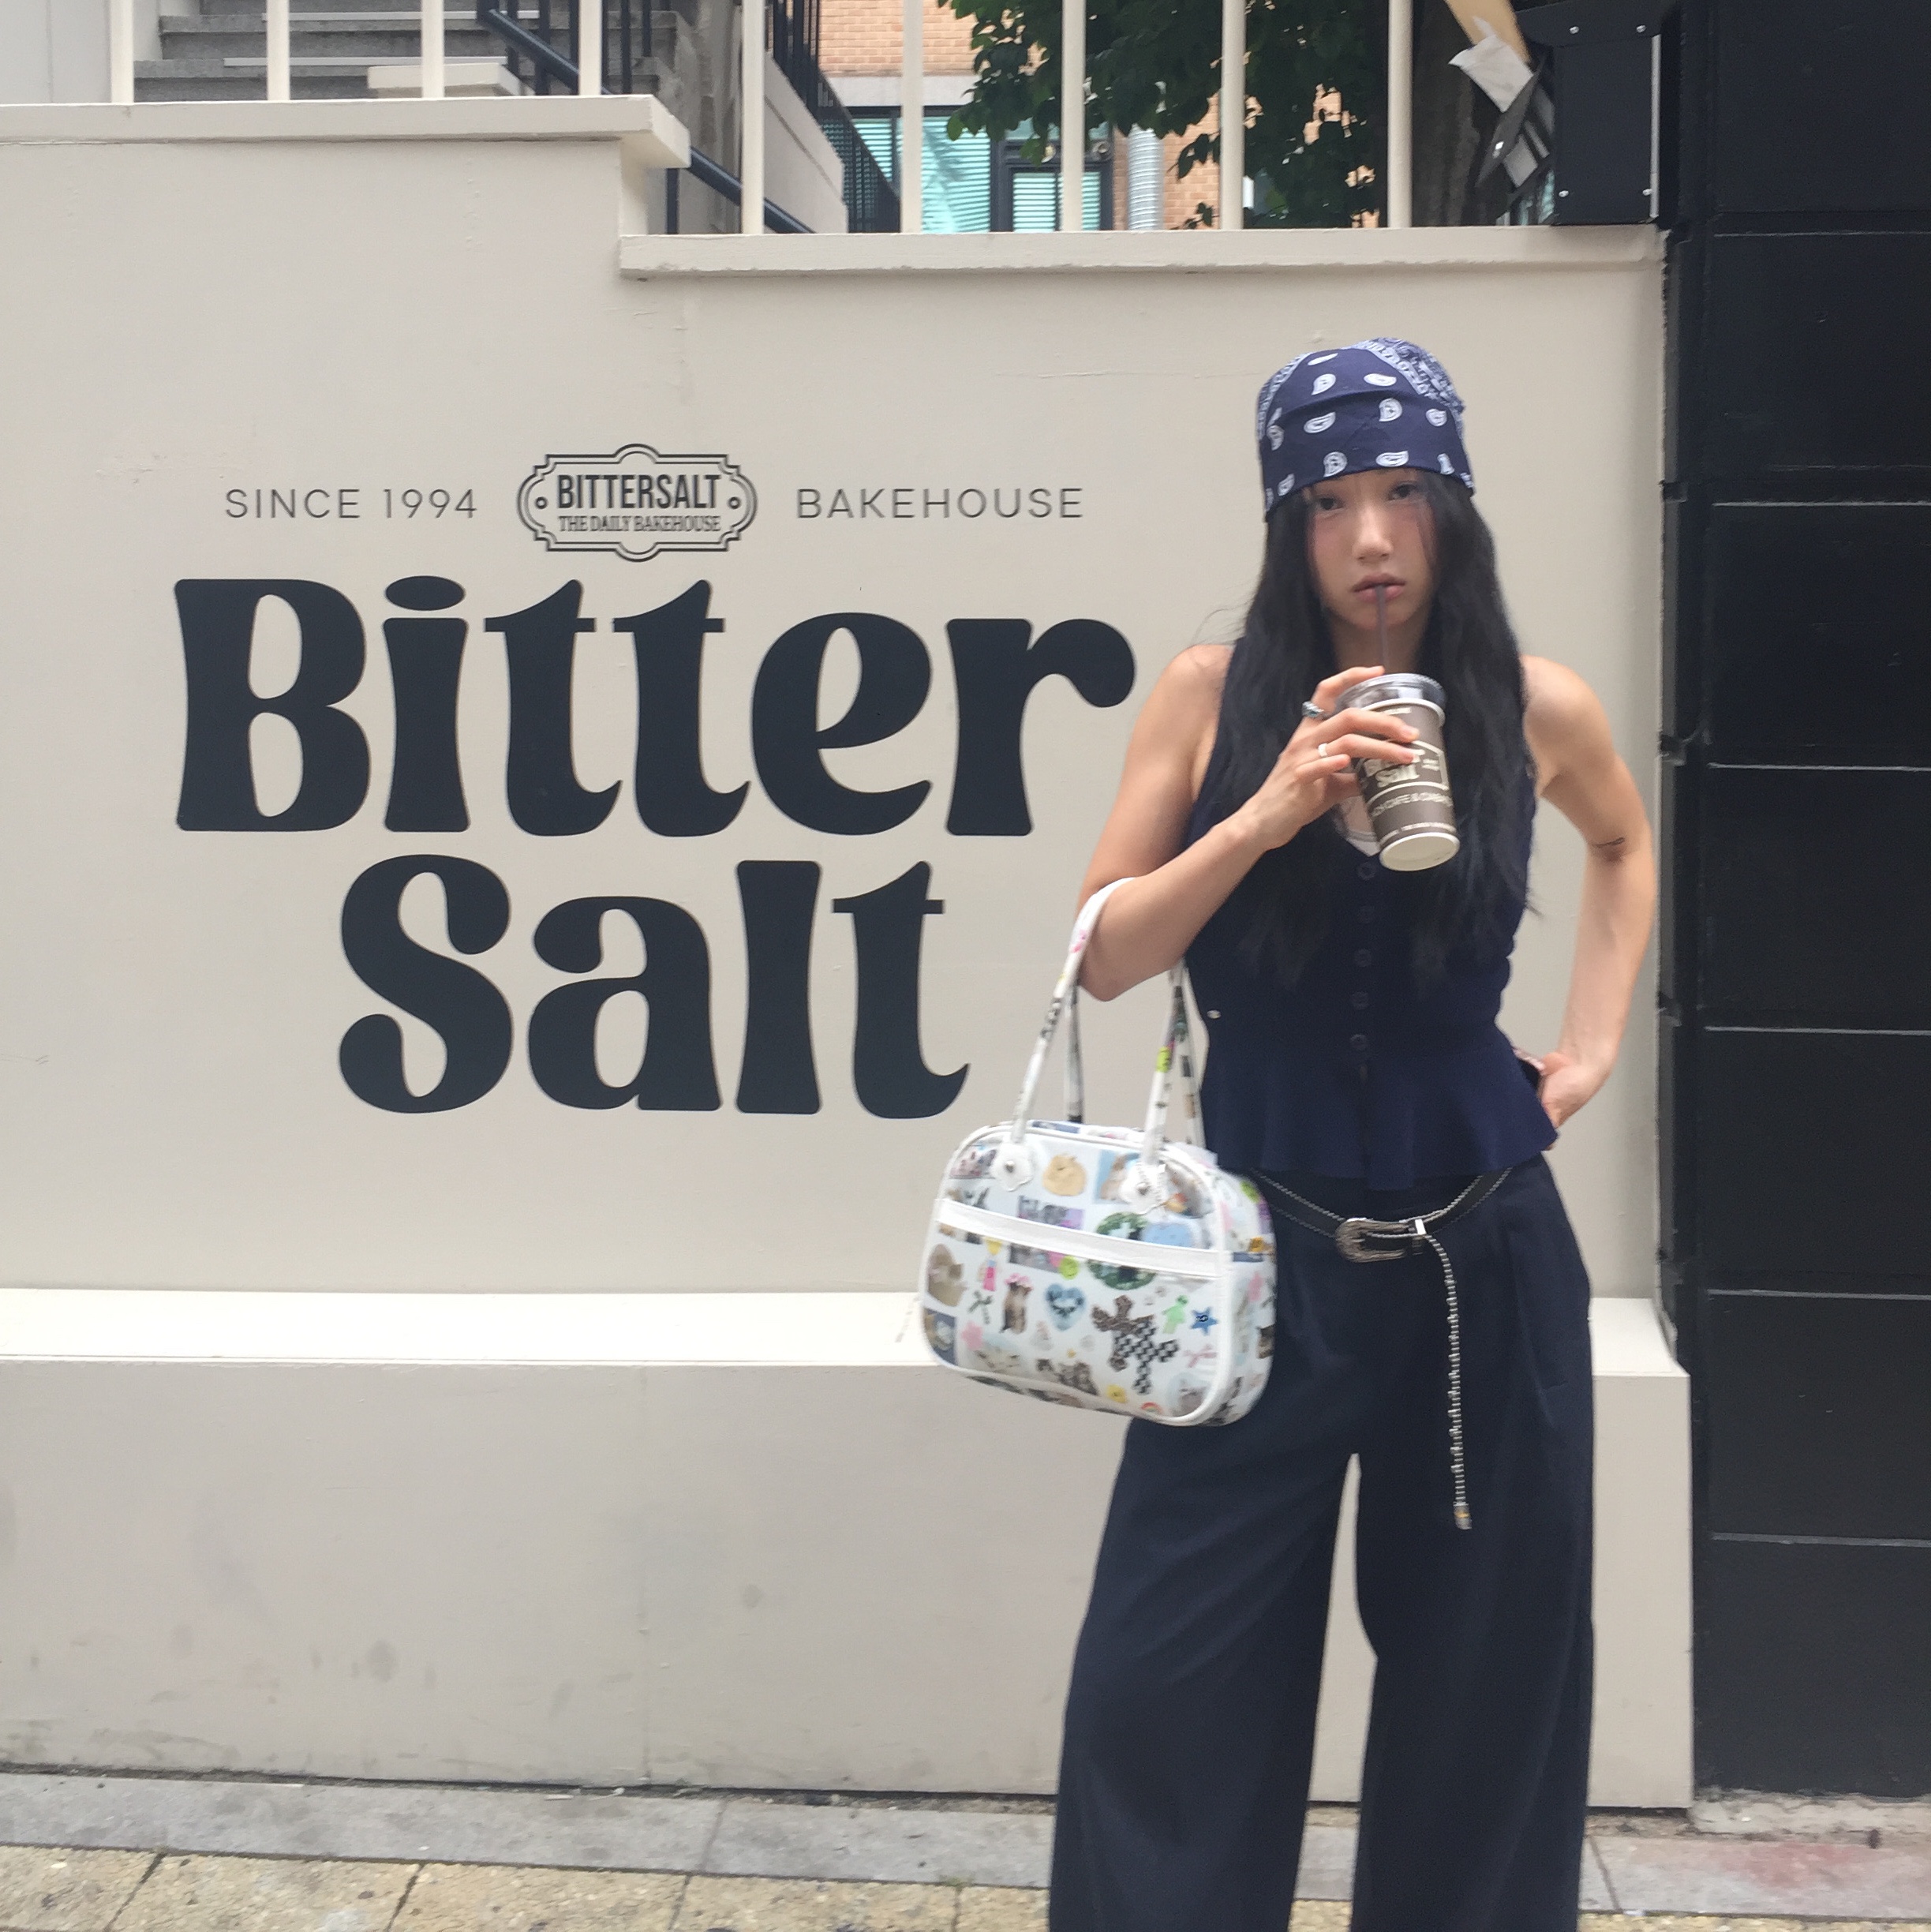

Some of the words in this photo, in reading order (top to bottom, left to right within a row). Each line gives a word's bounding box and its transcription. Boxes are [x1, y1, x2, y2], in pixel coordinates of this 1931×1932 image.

[225, 488, 361, 519] SINCE
[383, 488, 478, 519] 1994
[557, 474, 721, 510] BITTERSALT
[796, 487, 1083, 519] BAKEHOUSE
[558, 515, 588, 532] THE
[590, 515, 632, 532] DAILY
[634, 515, 721, 532] BAKEHOUSE
[174, 575, 1136, 837] Bitter
[338, 853, 970, 1120] Salt
